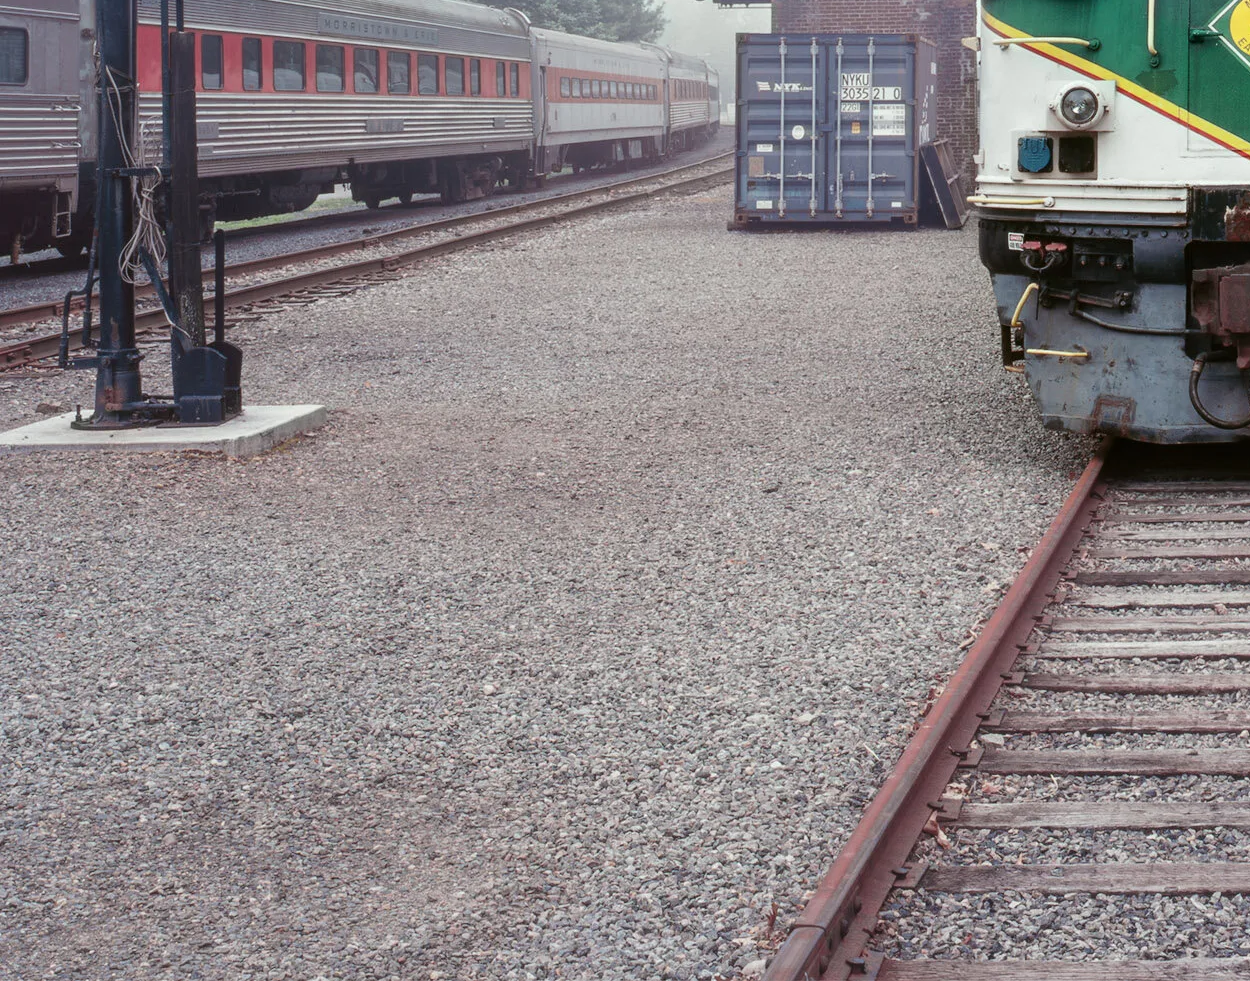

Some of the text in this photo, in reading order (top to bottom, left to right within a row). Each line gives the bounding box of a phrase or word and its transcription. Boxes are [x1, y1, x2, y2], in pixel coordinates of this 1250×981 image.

[324, 19, 398, 38] MORRISTOWN
[842, 74, 870, 86] NYKU
[773, 83, 800, 92] NYK
